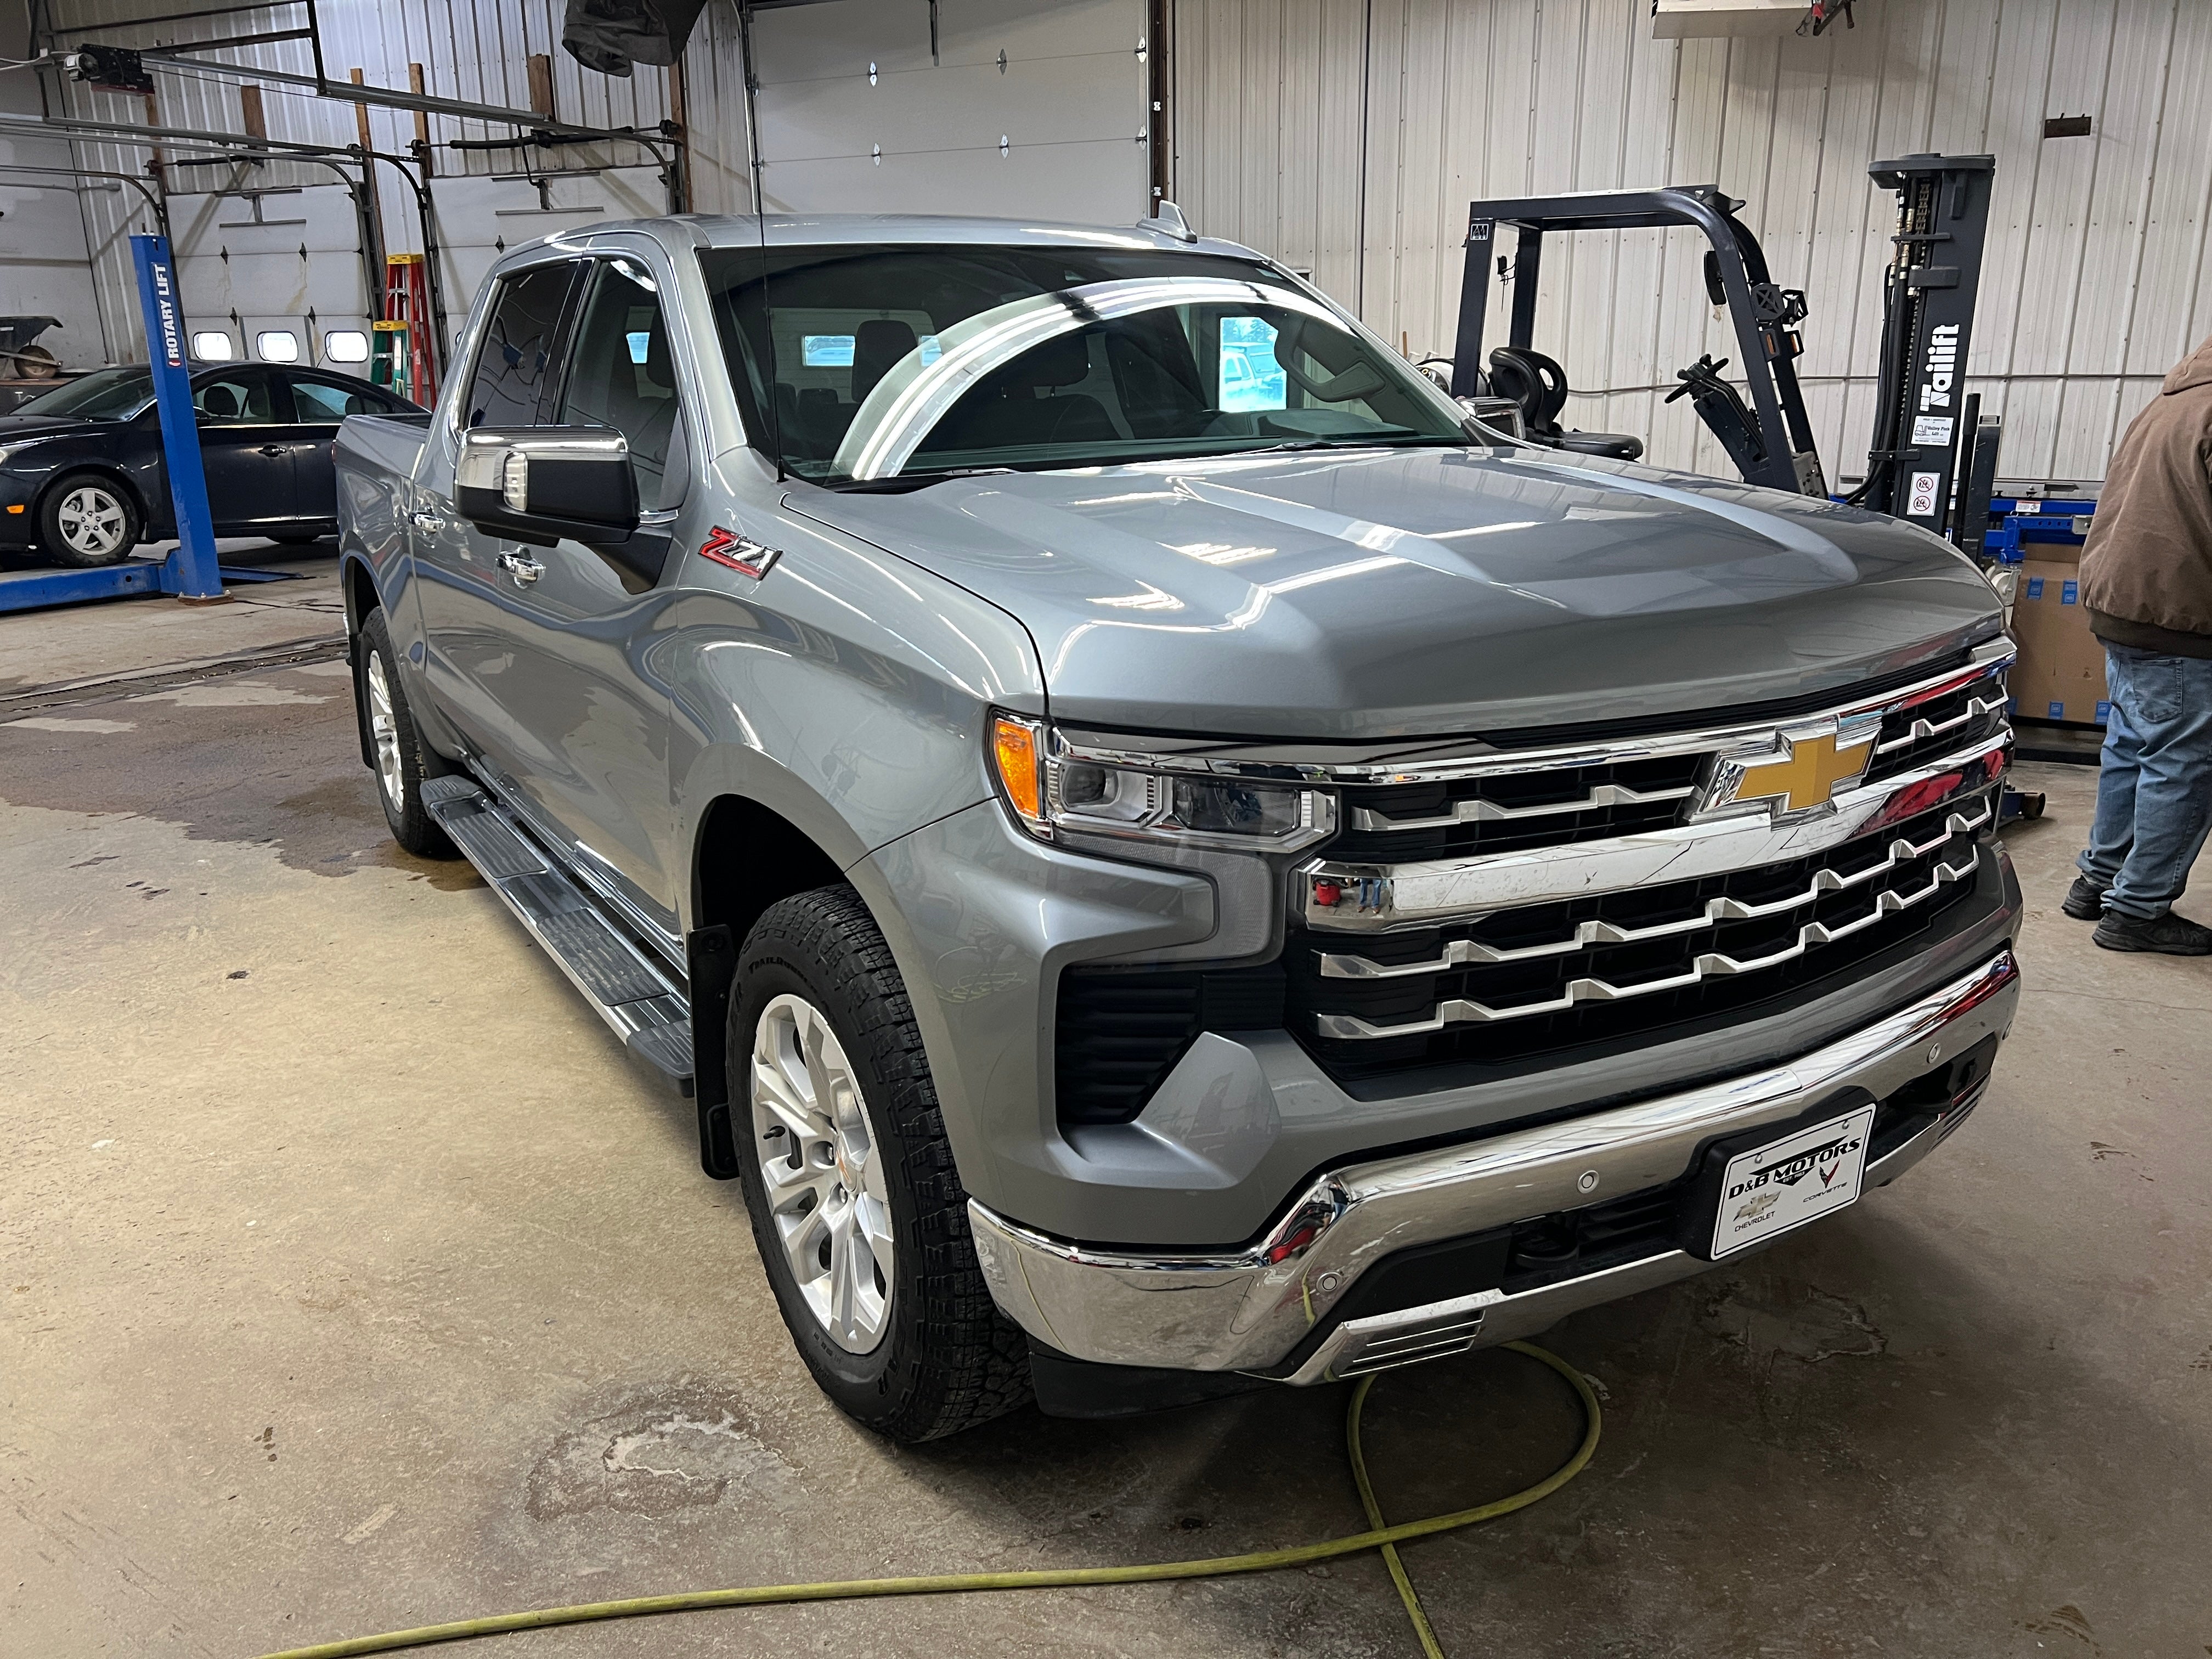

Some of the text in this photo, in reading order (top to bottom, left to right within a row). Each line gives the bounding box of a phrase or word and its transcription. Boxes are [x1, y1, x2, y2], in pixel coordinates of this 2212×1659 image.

[155, 264, 179, 358] ROTARY LIFT
[1920, 324, 1959, 411] Tailift
[698, 524, 783, 580] Z71
[1729, 1137, 1861, 1199] D&B MOTORS
[1803, 1182, 1848, 1203] CORVETTE
[1735, 1211, 1775, 1232] CHEVROLET
